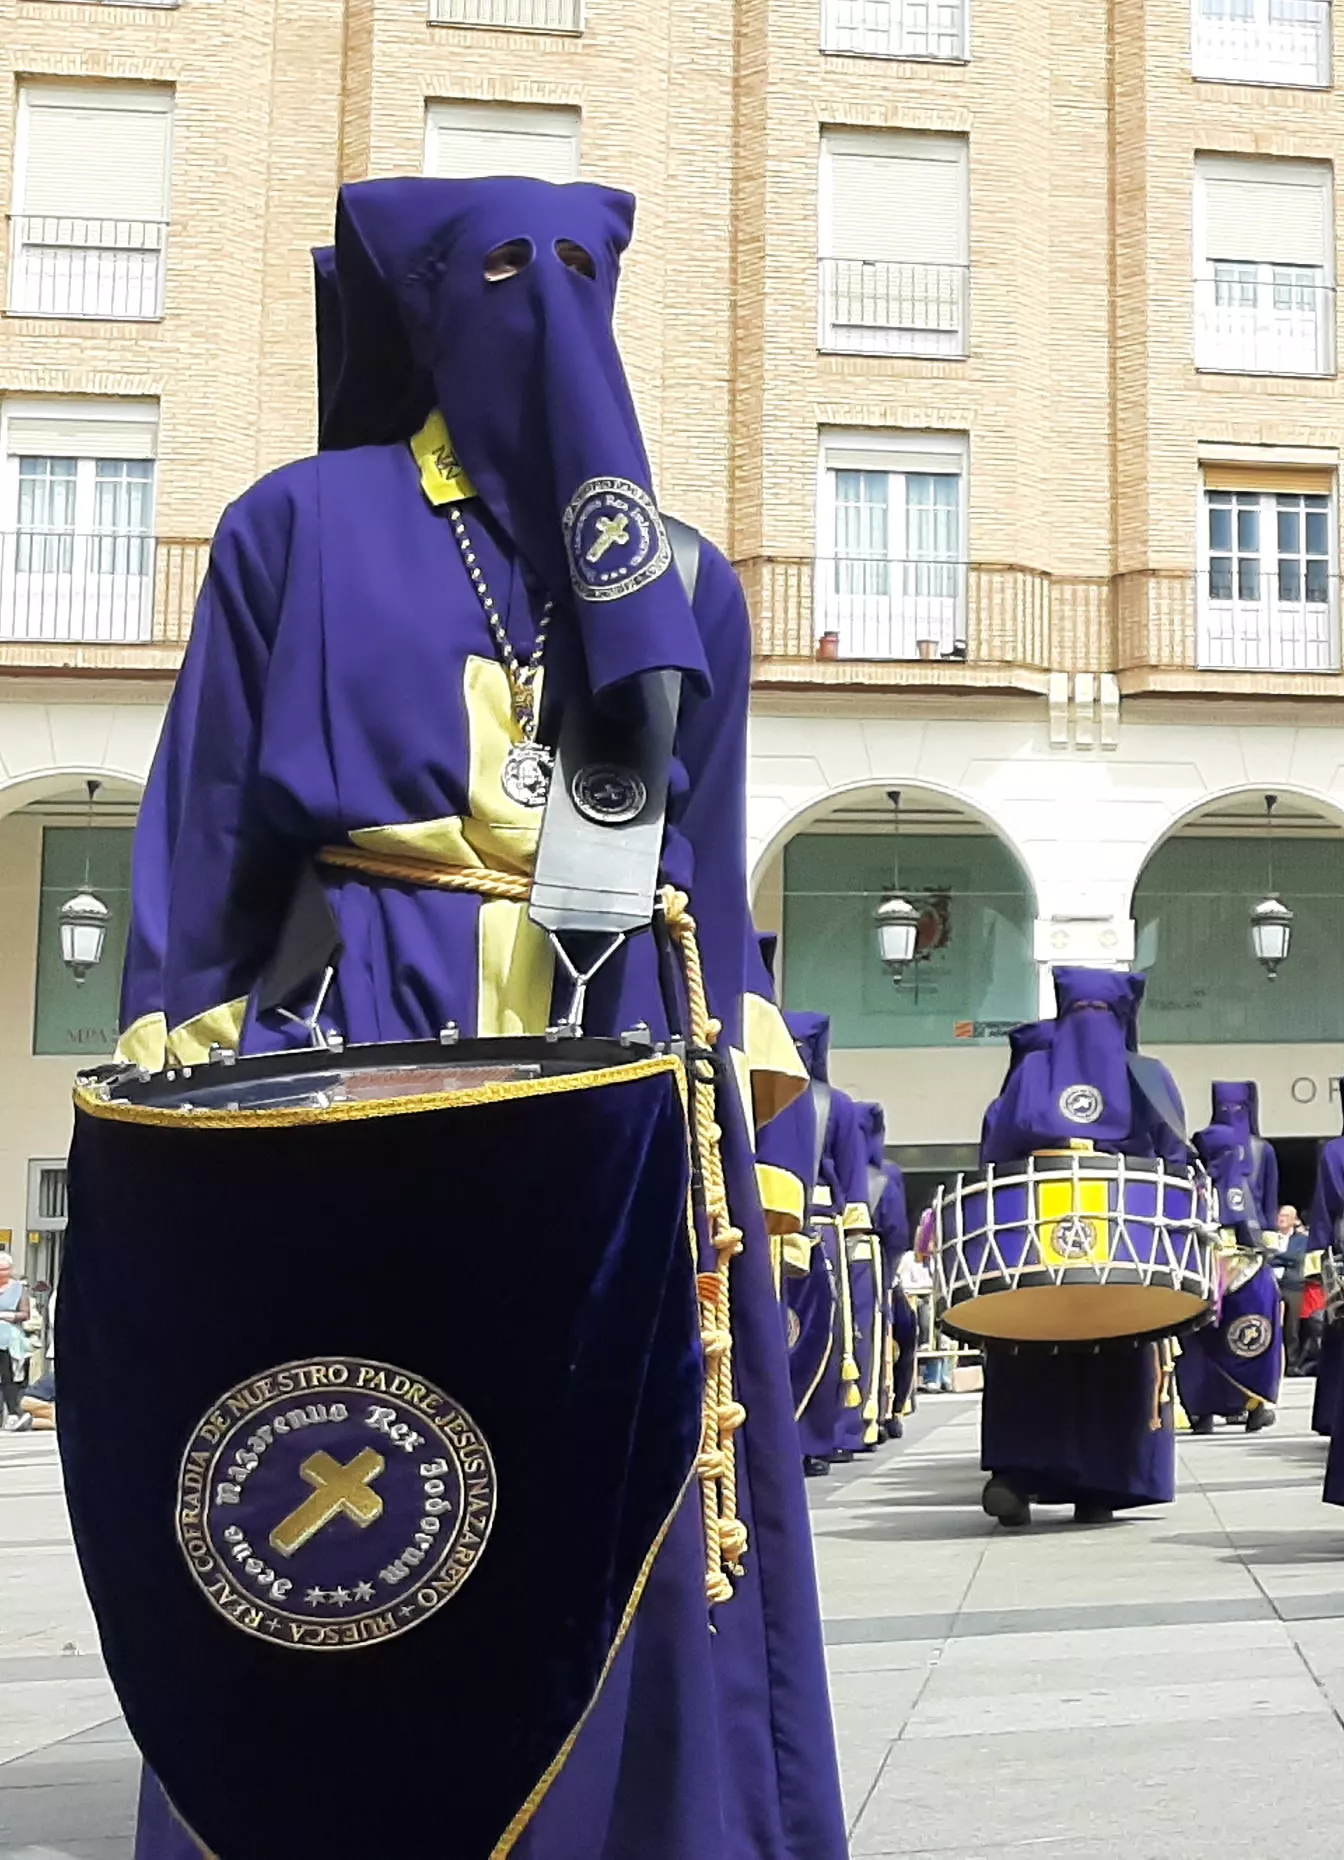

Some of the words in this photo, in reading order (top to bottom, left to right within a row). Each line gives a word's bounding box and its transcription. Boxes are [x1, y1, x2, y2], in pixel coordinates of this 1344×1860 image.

[226, 1363, 349, 1417] NUESTRO
[355, 1365, 443, 1415] PADRE
[200, 1410, 232, 1445] DE
[435, 1408, 487, 1473] JESUS
[180, 1450, 215, 1572] COFRADIA
[416, 1474, 490, 1608] NAZARENO
[206, 1573, 265, 1630] REAL
[289, 1611, 398, 1644] HUESCA
